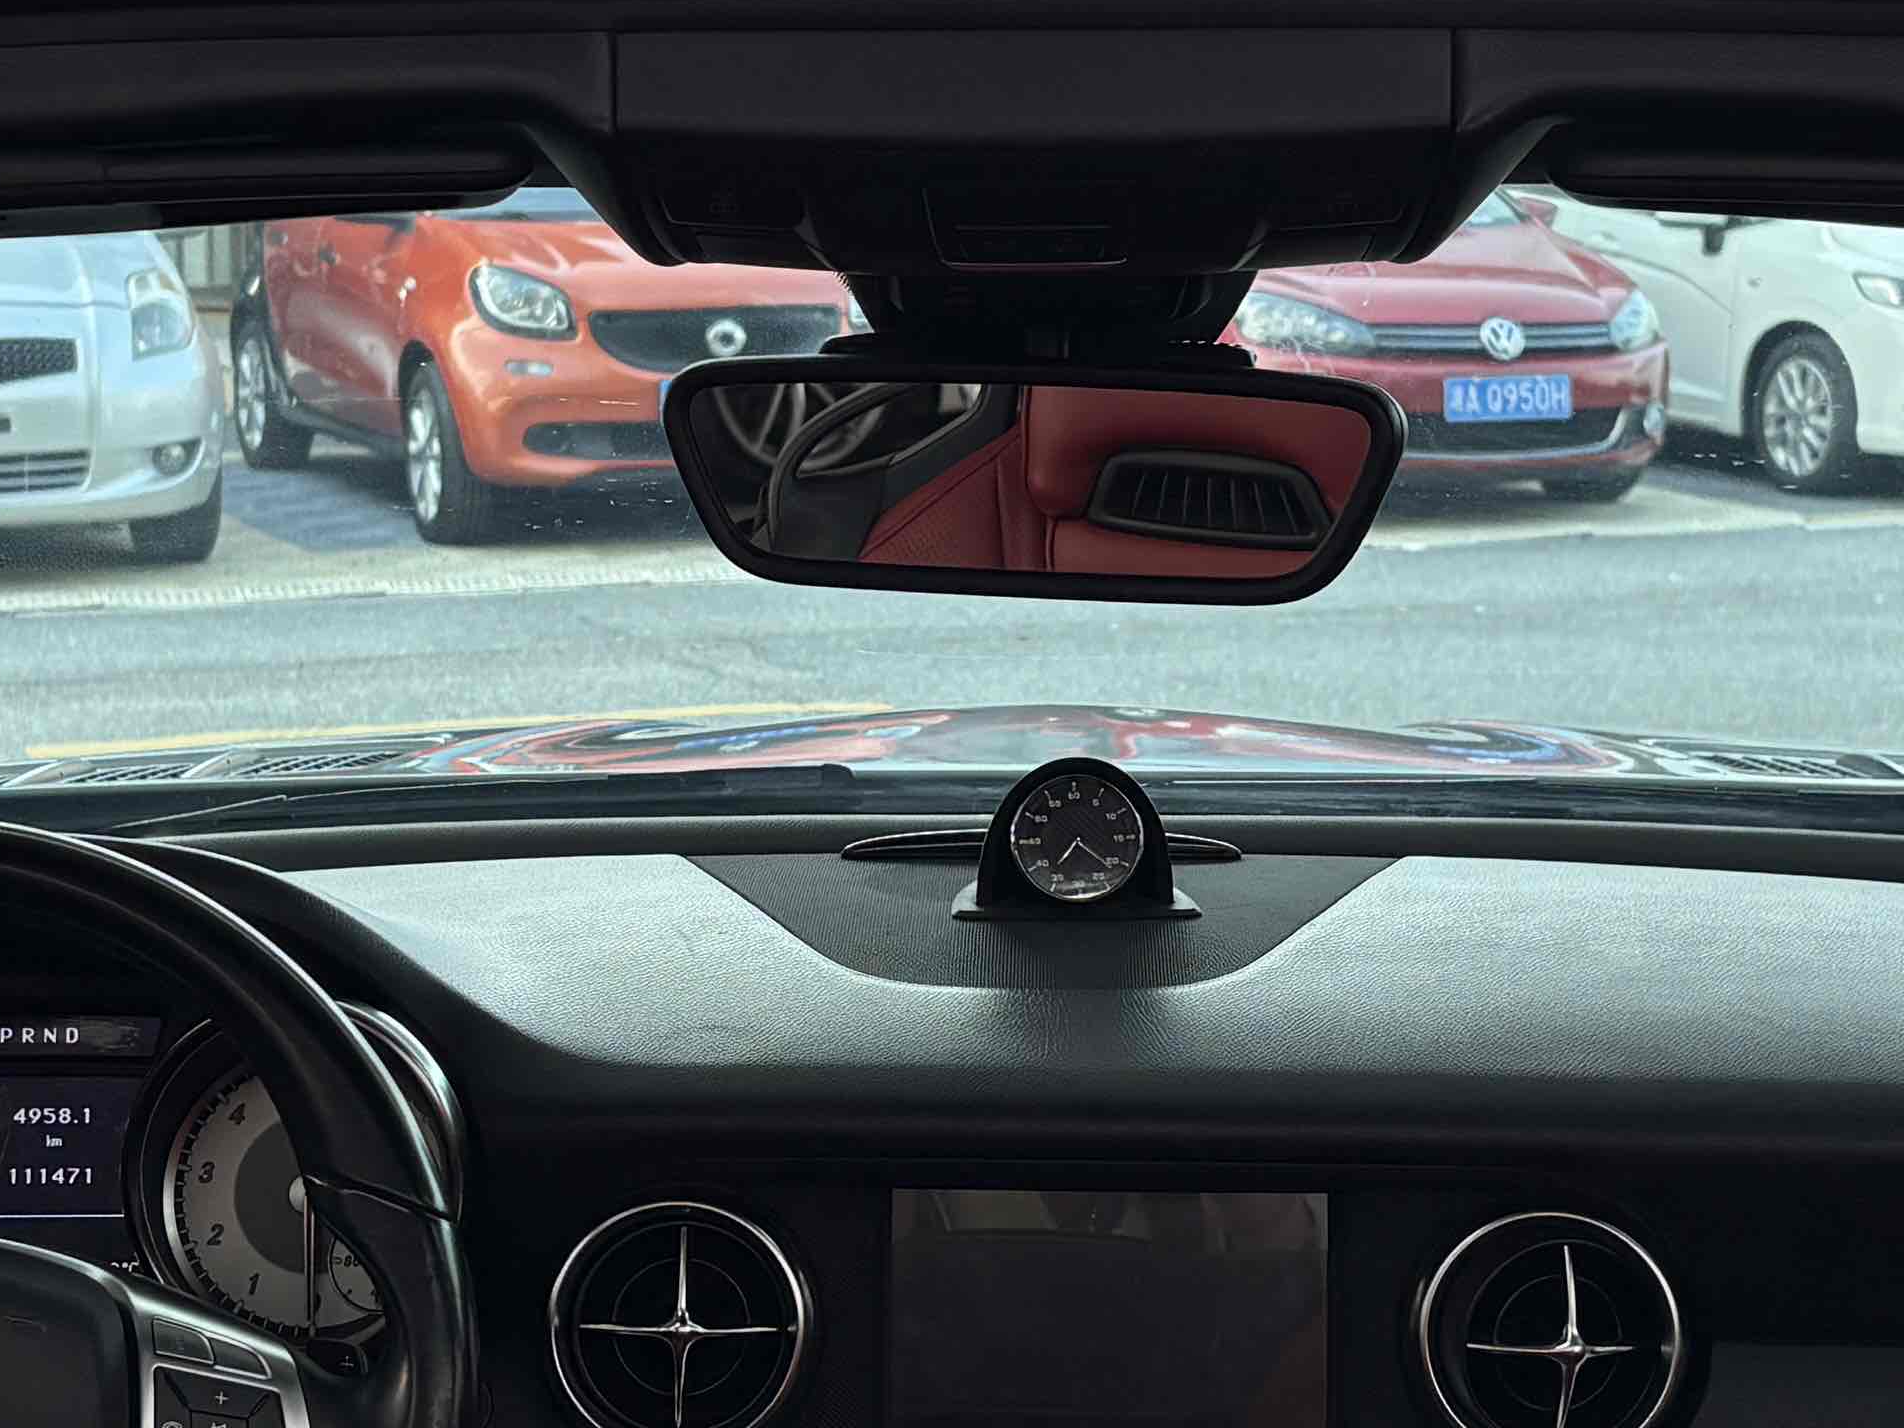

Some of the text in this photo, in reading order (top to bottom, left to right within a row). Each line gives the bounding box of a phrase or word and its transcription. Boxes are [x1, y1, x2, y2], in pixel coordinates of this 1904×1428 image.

[0, 1027, 80, 1044] P R N D
[13, 1107, 92, 1124] 4958.1
[228, 1103, 245, 1125] 4
[9, 1167, 93, 1185] 111471
[199, 1162, 215, 1183] 3
[207, 1224, 224, 1246] 2
[249, 1273, 260, 1295] 1
